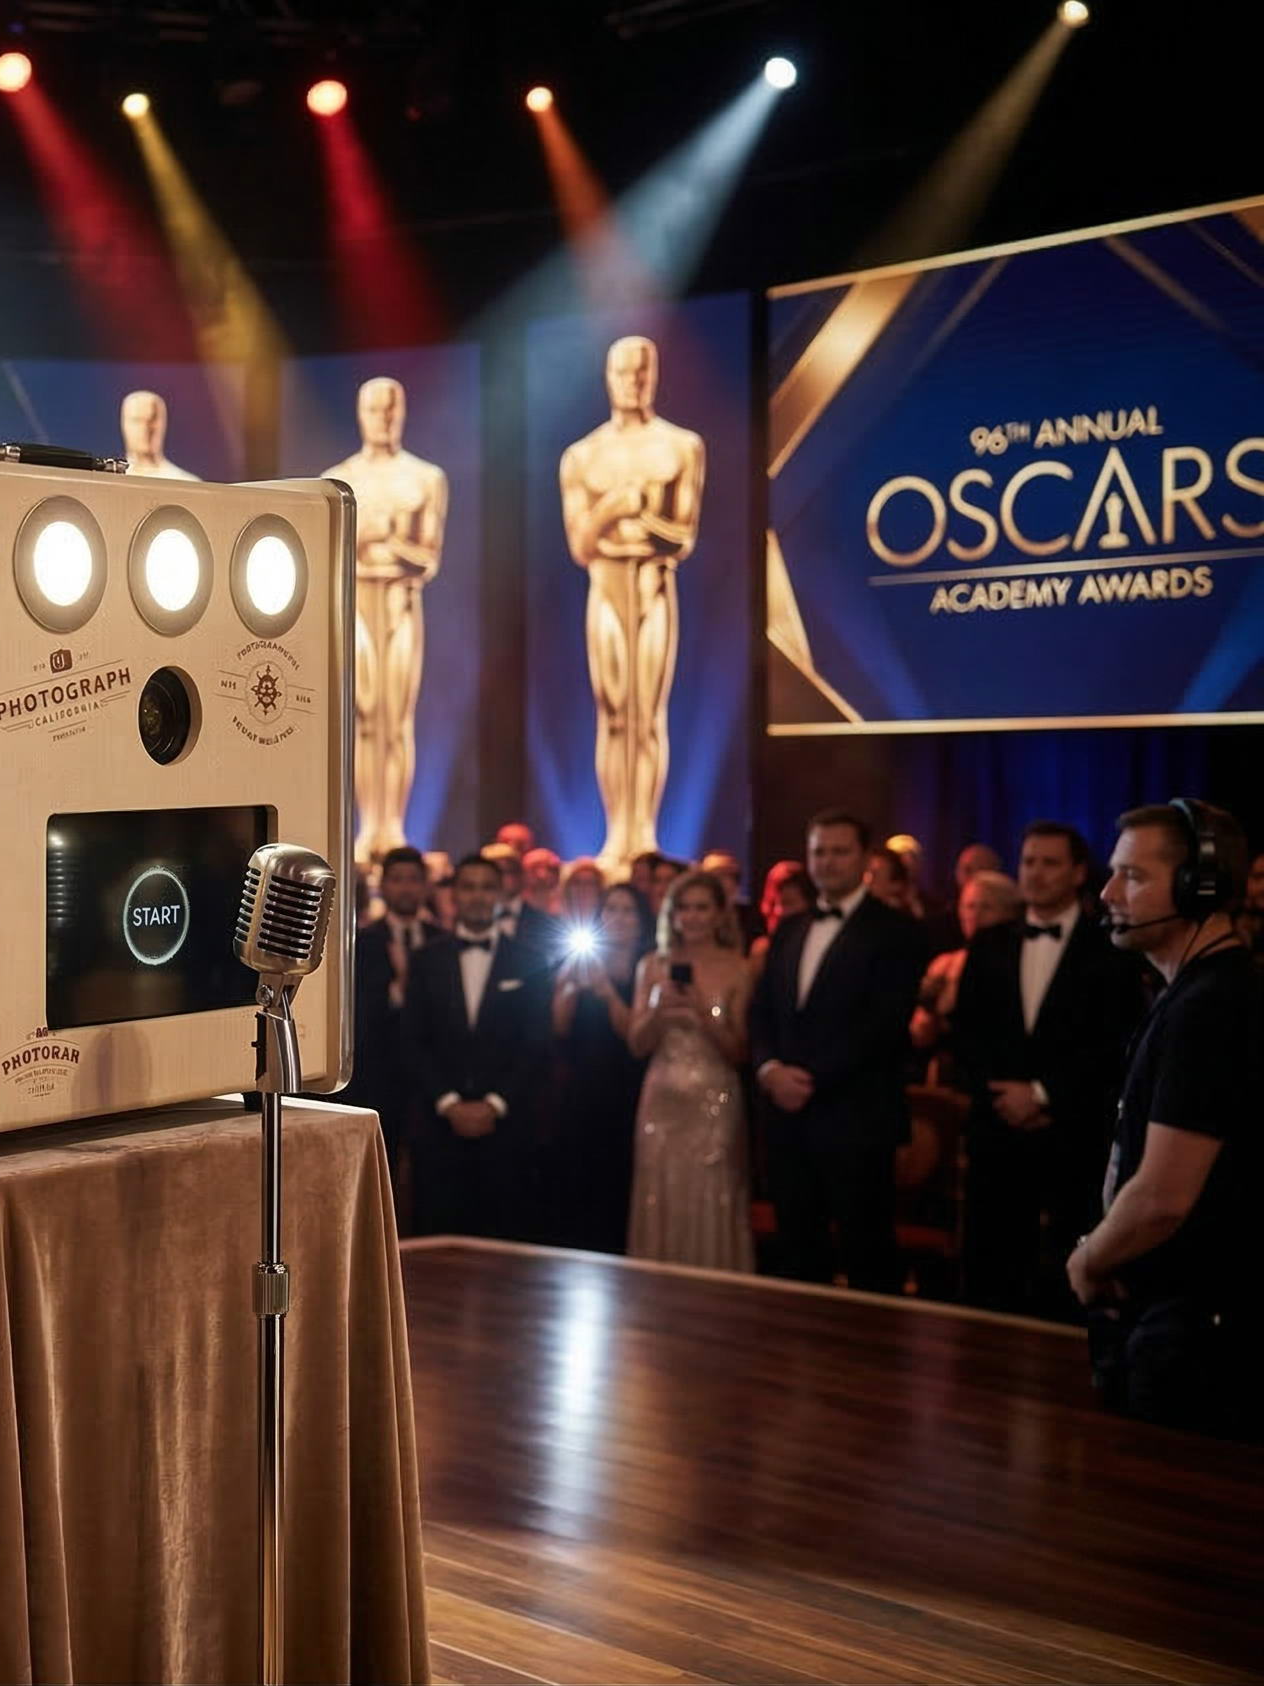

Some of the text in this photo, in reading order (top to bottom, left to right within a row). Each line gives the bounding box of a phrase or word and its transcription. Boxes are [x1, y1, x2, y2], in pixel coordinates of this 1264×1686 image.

[1033, 405, 1164, 449] ANNUAL
[866, 436, 1264, 567] OSCARS
[929, 566, 1214, 615] ACADEMY AWARDS
[132, 905, 181, 927] START
